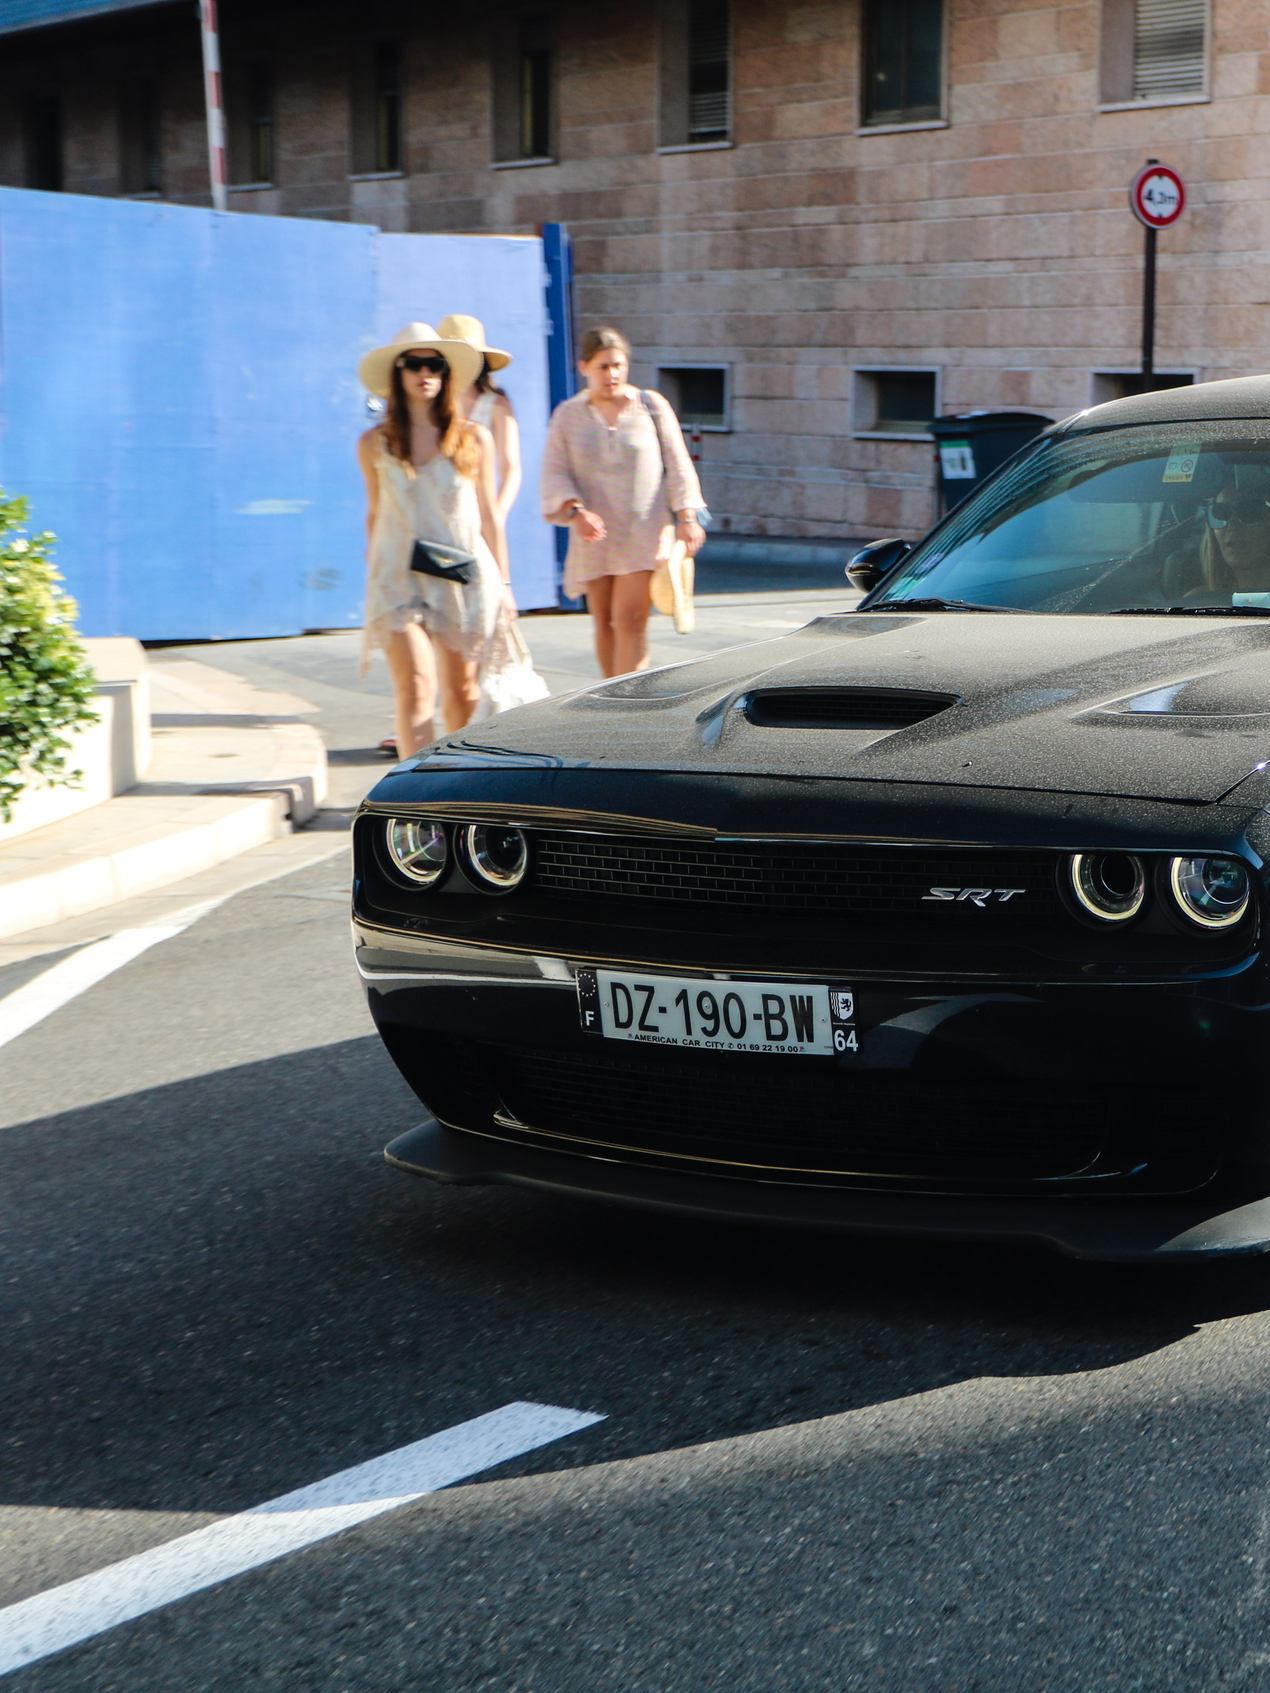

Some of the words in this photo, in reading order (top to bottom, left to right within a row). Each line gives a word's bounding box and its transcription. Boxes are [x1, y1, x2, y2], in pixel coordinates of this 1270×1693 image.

[921, 887, 1026, 907] SRT
[585, 1010, 594, 1026] F
[610, 981, 814, 1043] DZ-190-BW
[634, 1033, 678, 1045] AMERICAN
[682, 1038, 700, 1047] CAR
[705, 1040, 725, 1049] CITY
[749, 1043, 760, 1051] 69
[787, 1045, 798, 1053] 00
[834, 1029, 858, 1051] 64
